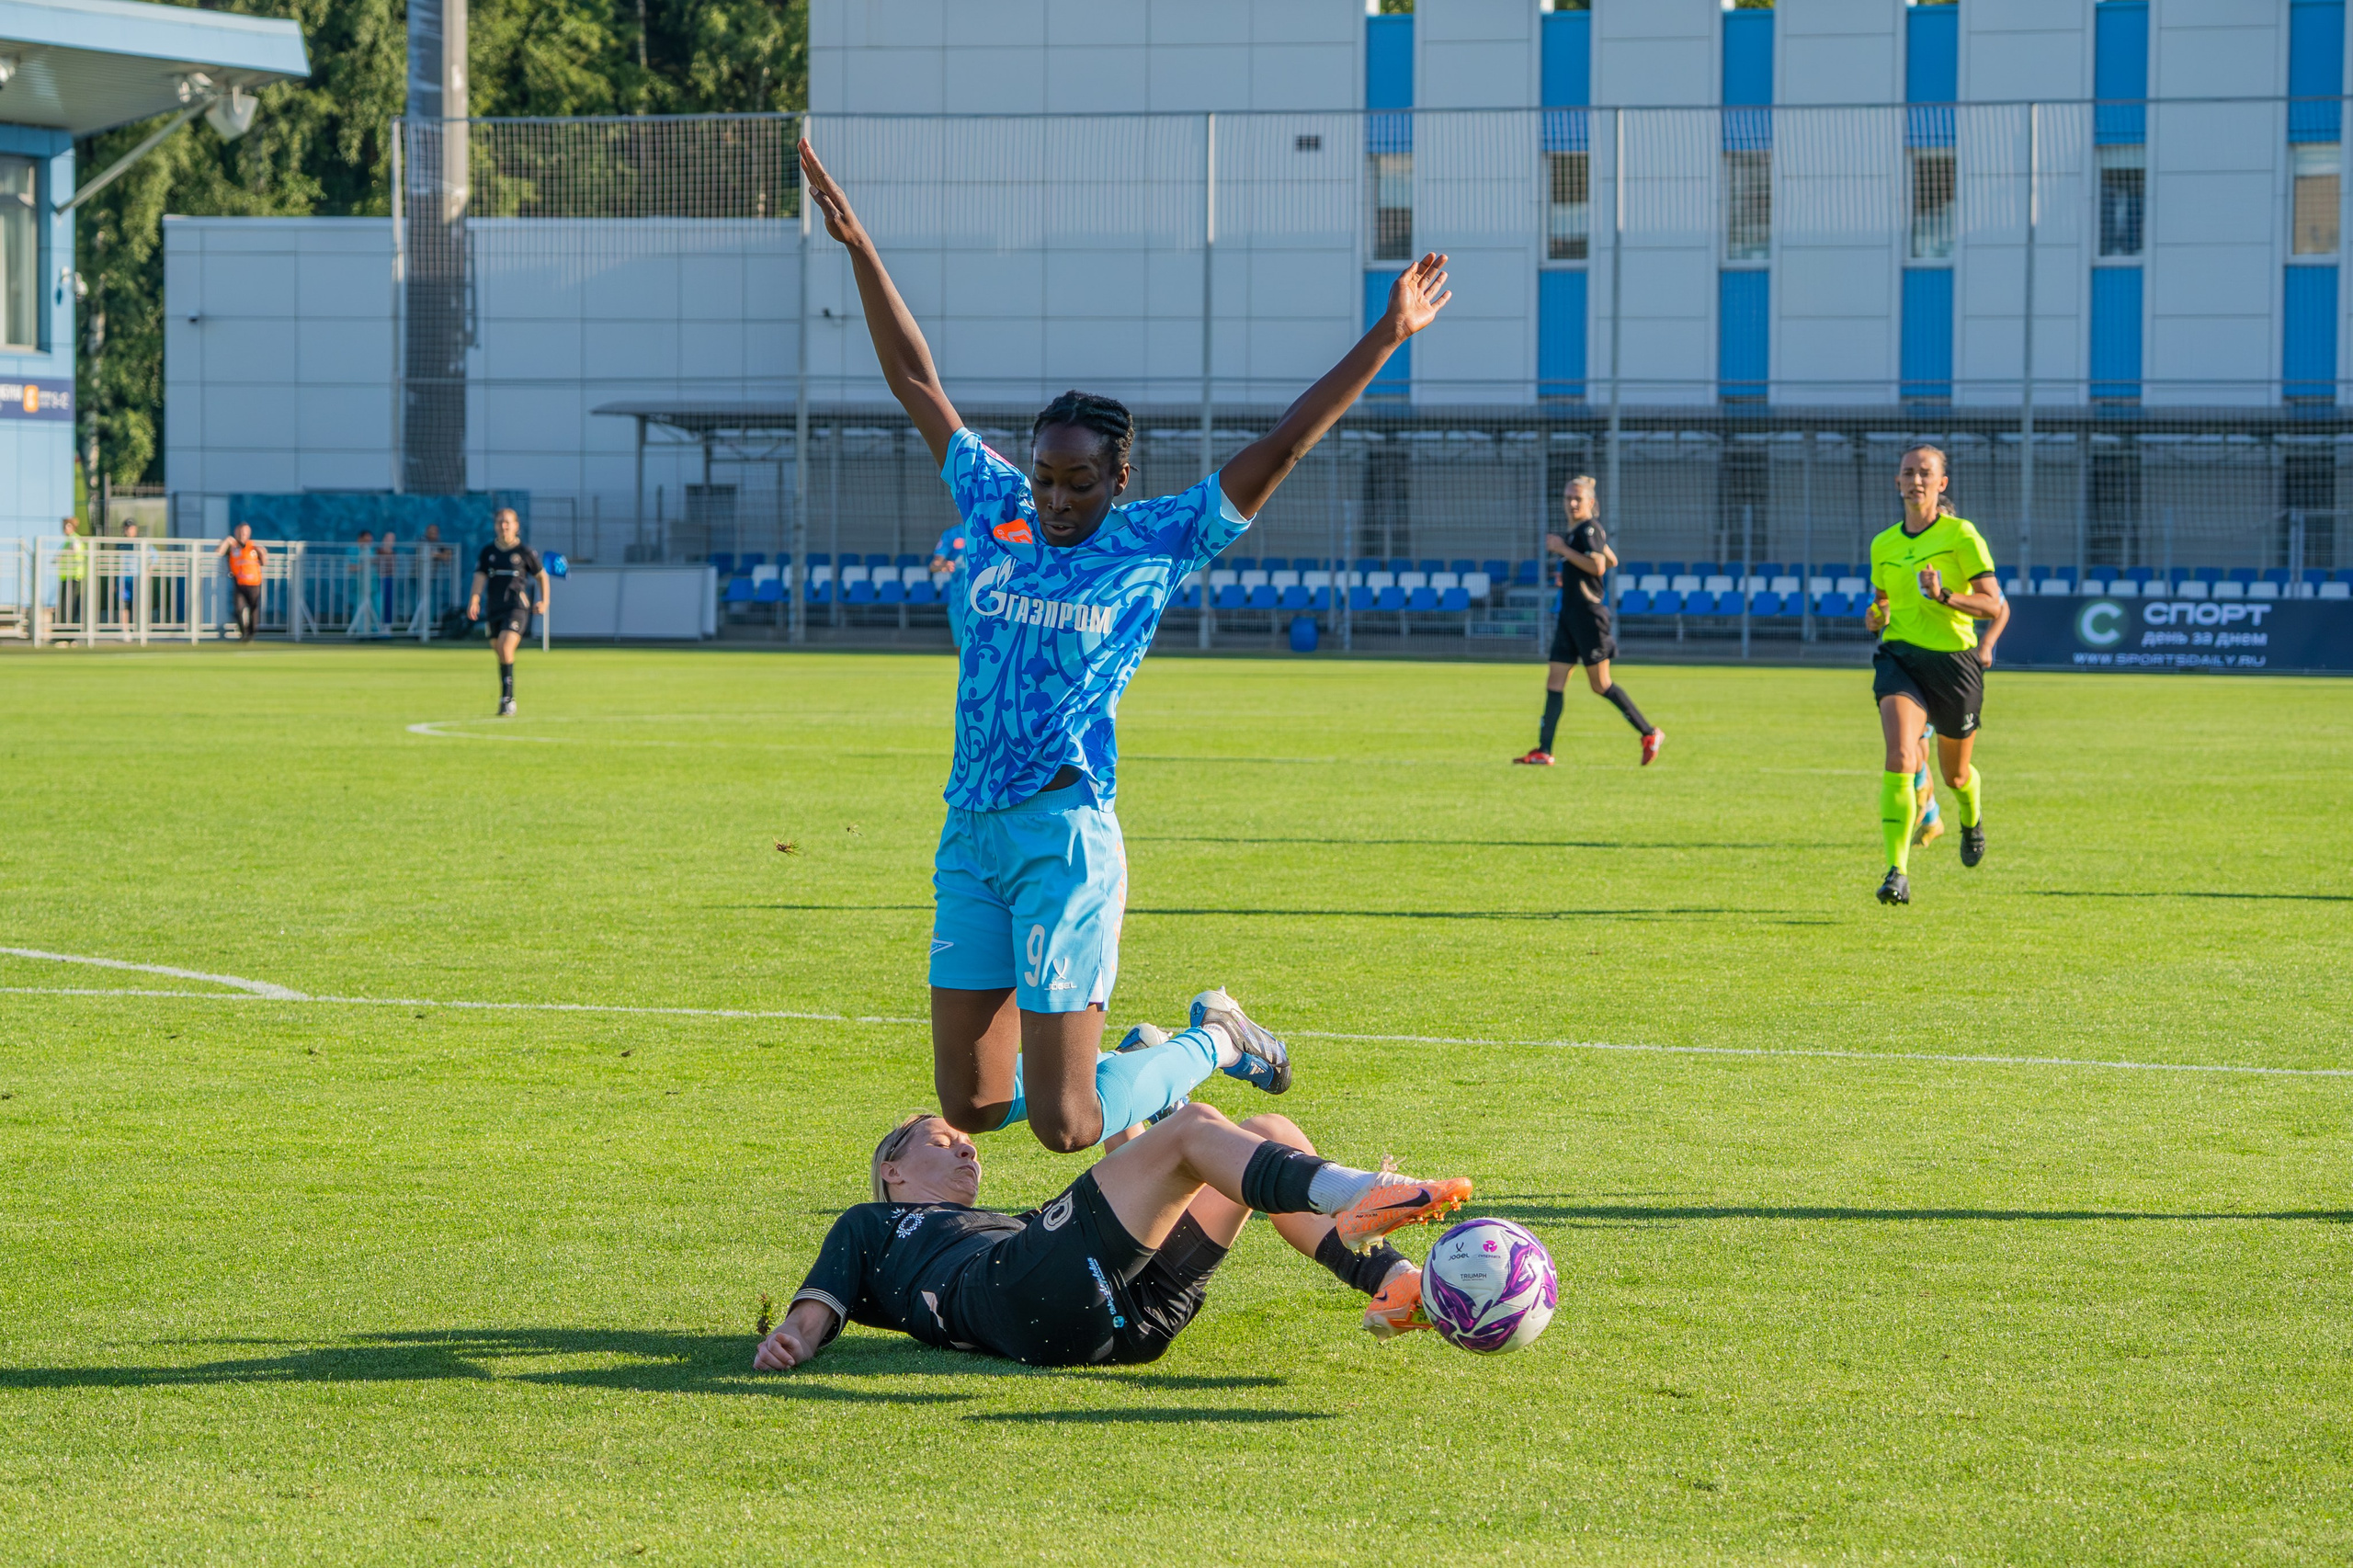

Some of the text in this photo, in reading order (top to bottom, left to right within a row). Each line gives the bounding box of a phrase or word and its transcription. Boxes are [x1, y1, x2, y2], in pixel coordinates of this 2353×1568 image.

[1005, 593, 1112, 634] ГАЗПРОМ
[2143, 602, 2272, 626] СПОРТ
[1024, 924, 1045, 987] 9
